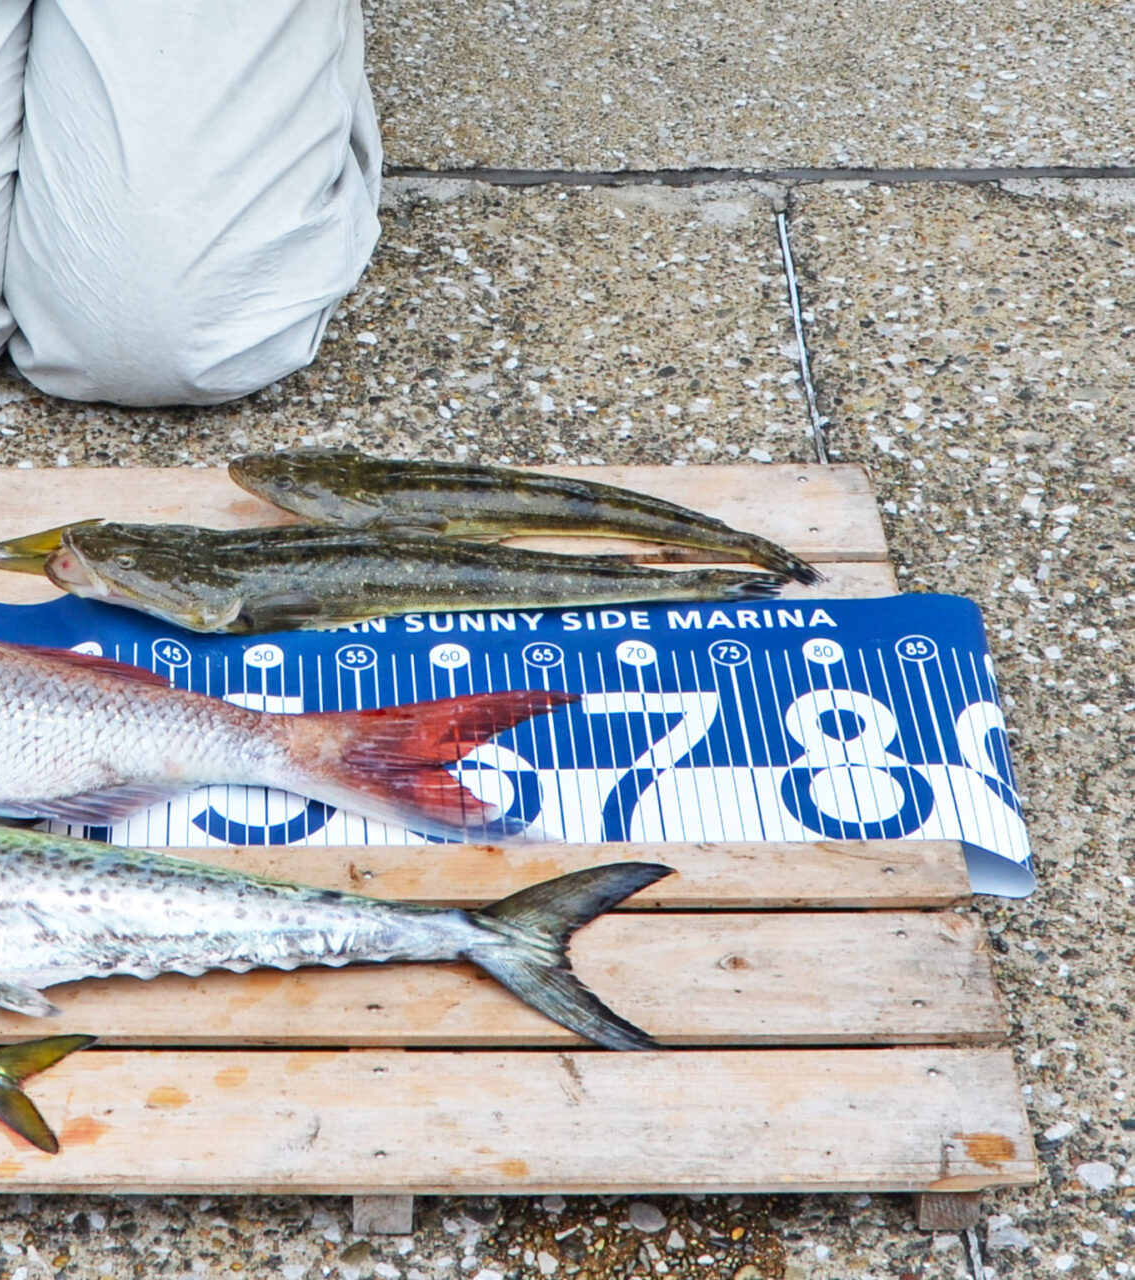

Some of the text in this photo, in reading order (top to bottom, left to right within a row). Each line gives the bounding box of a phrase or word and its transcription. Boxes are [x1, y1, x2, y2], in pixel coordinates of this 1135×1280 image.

[404, 612, 545, 634] SUNNY
[561, 610, 651, 632] SIDE
[667, 608, 838, 630] MARINA
[162, 641, 928, 663] 45 50 55 60 65 70 75 80 85
[581, 691, 719, 843] 7
[780, 688, 935, 841] 8
